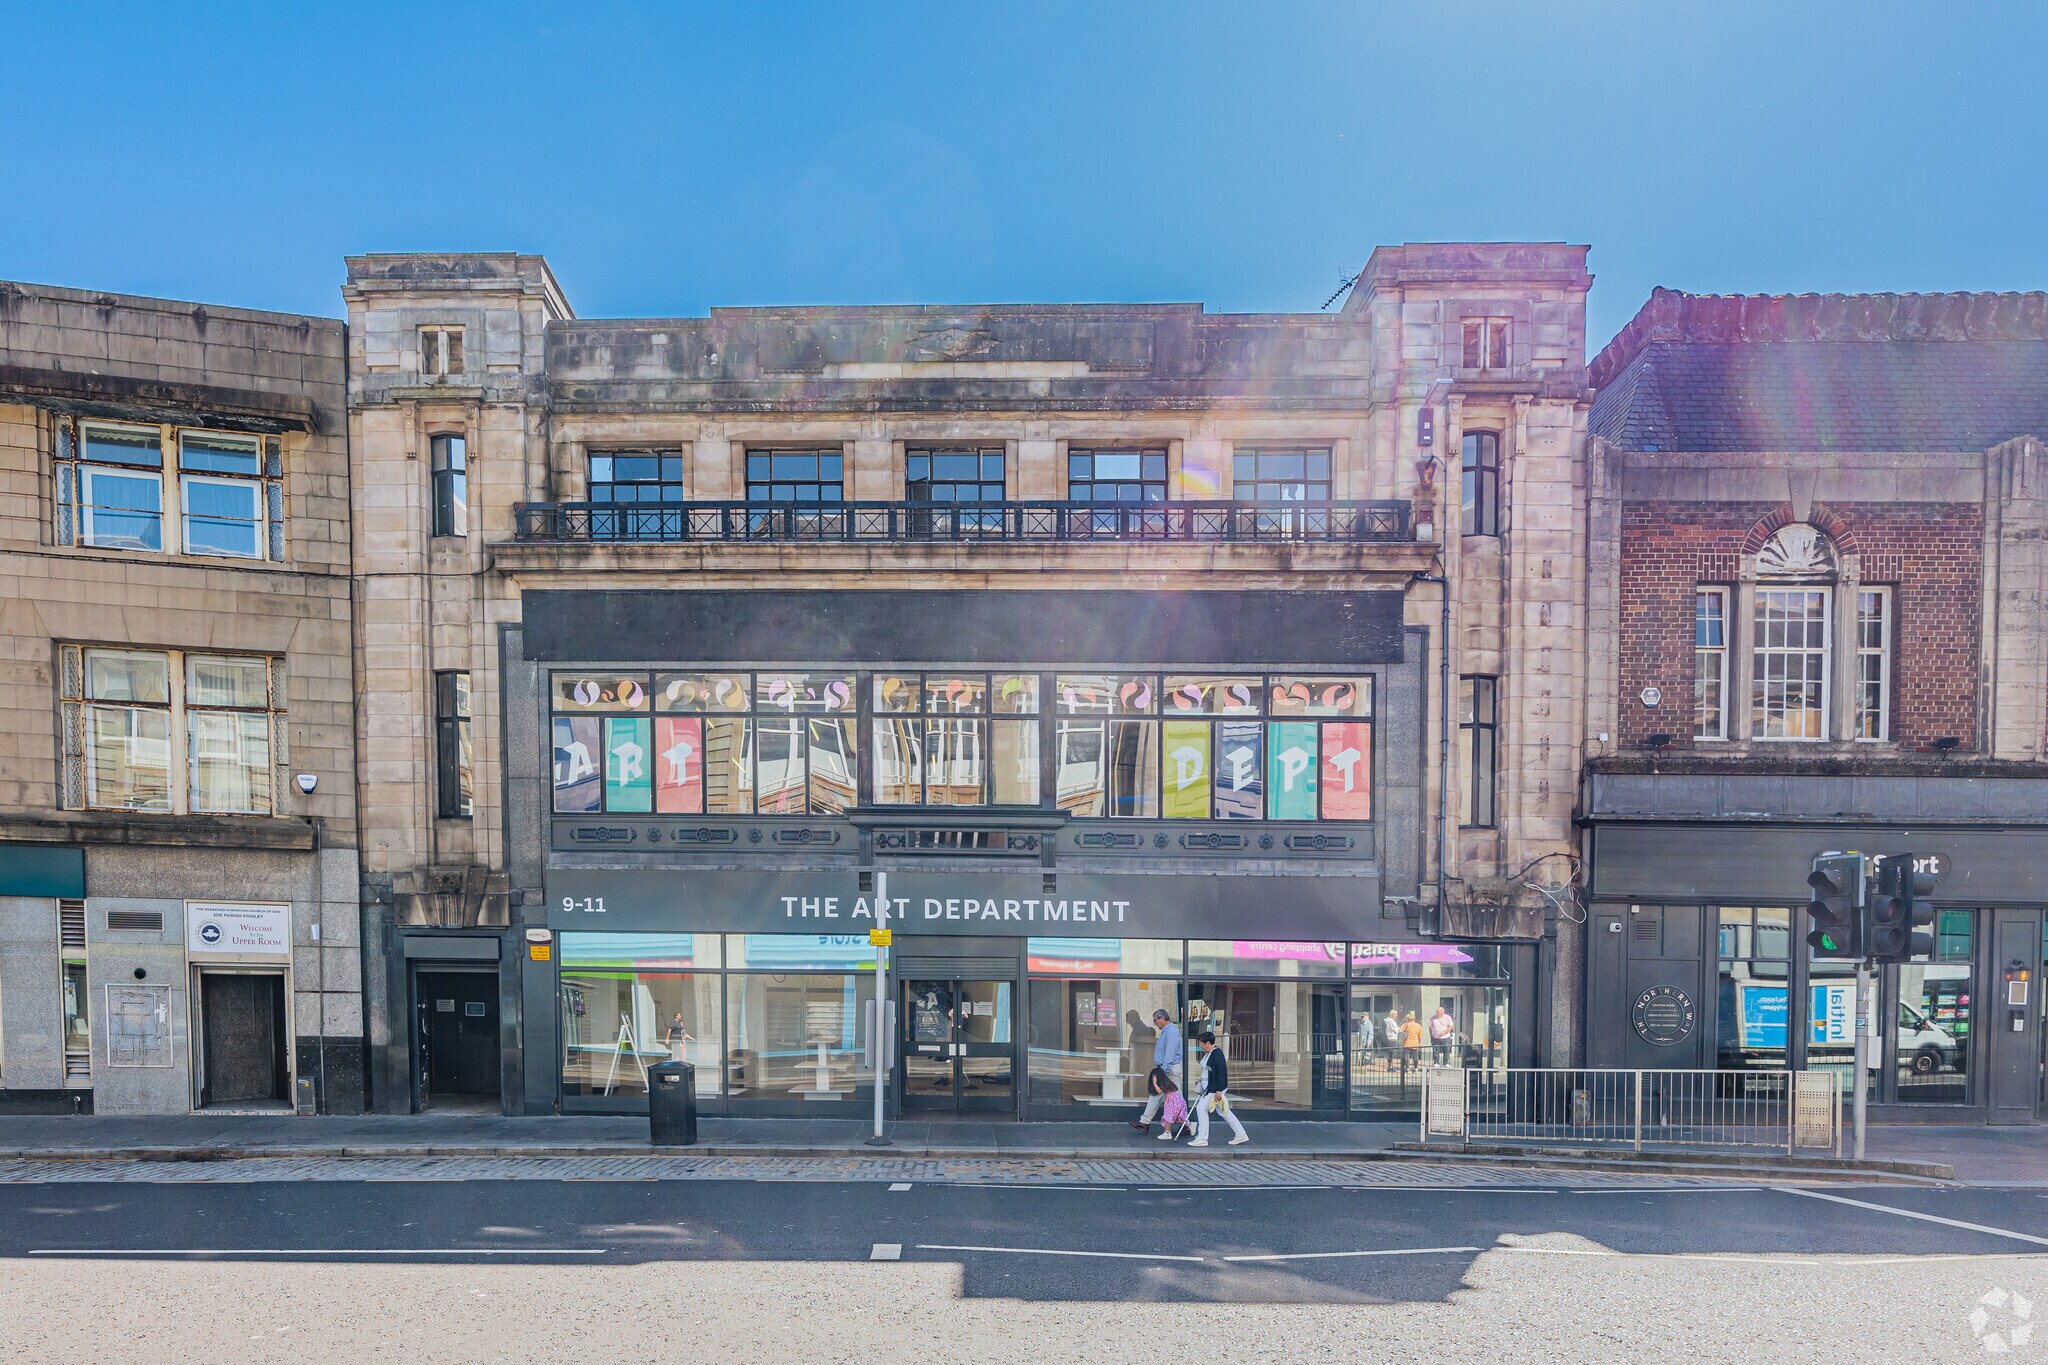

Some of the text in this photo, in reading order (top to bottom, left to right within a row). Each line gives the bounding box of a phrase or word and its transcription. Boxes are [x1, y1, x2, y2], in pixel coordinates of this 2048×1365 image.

[563, 741, 1361, 793] ART DEPT
[562, 896, 606, 912] 9-11
[781, 896, 839, 918] THE
[924, 898, 1130, 922] DEPARTMENT
